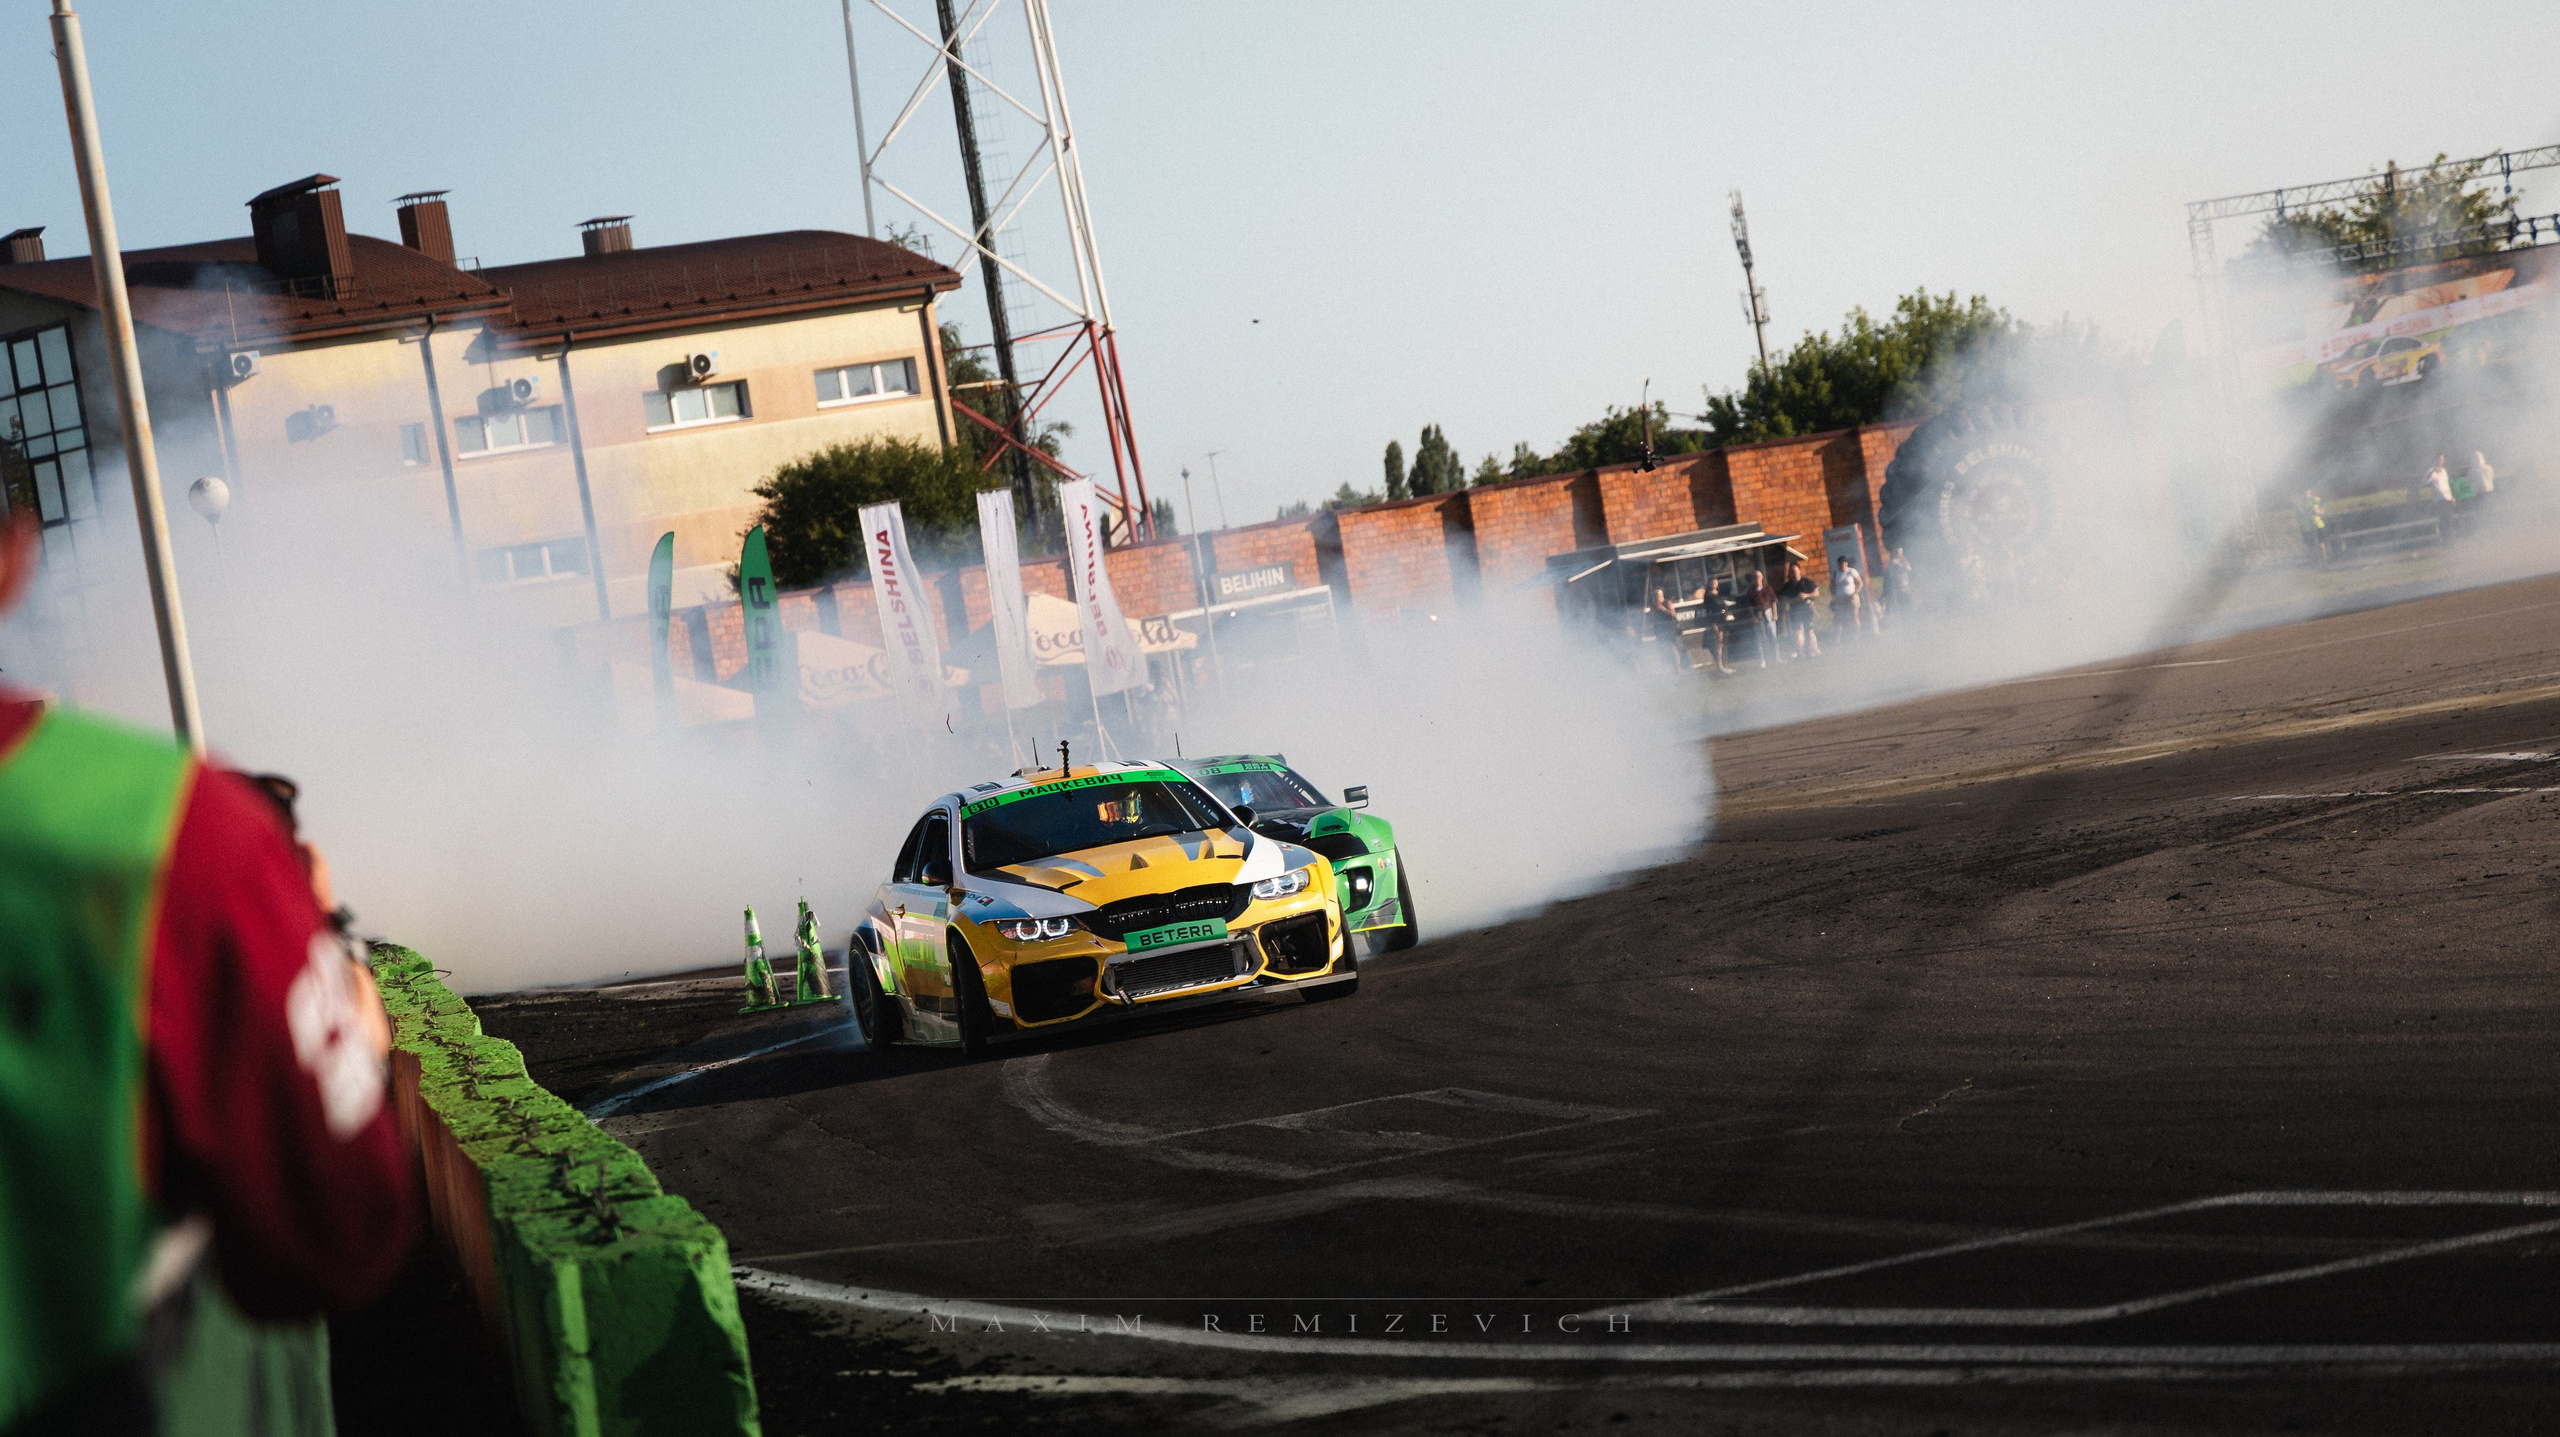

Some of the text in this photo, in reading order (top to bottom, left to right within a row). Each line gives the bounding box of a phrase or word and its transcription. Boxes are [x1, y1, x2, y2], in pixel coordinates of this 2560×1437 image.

[875, 529, 924, 666] BELSHINA
[970, 773, 1124, 813] 810 МАЦКЕВИЧ
